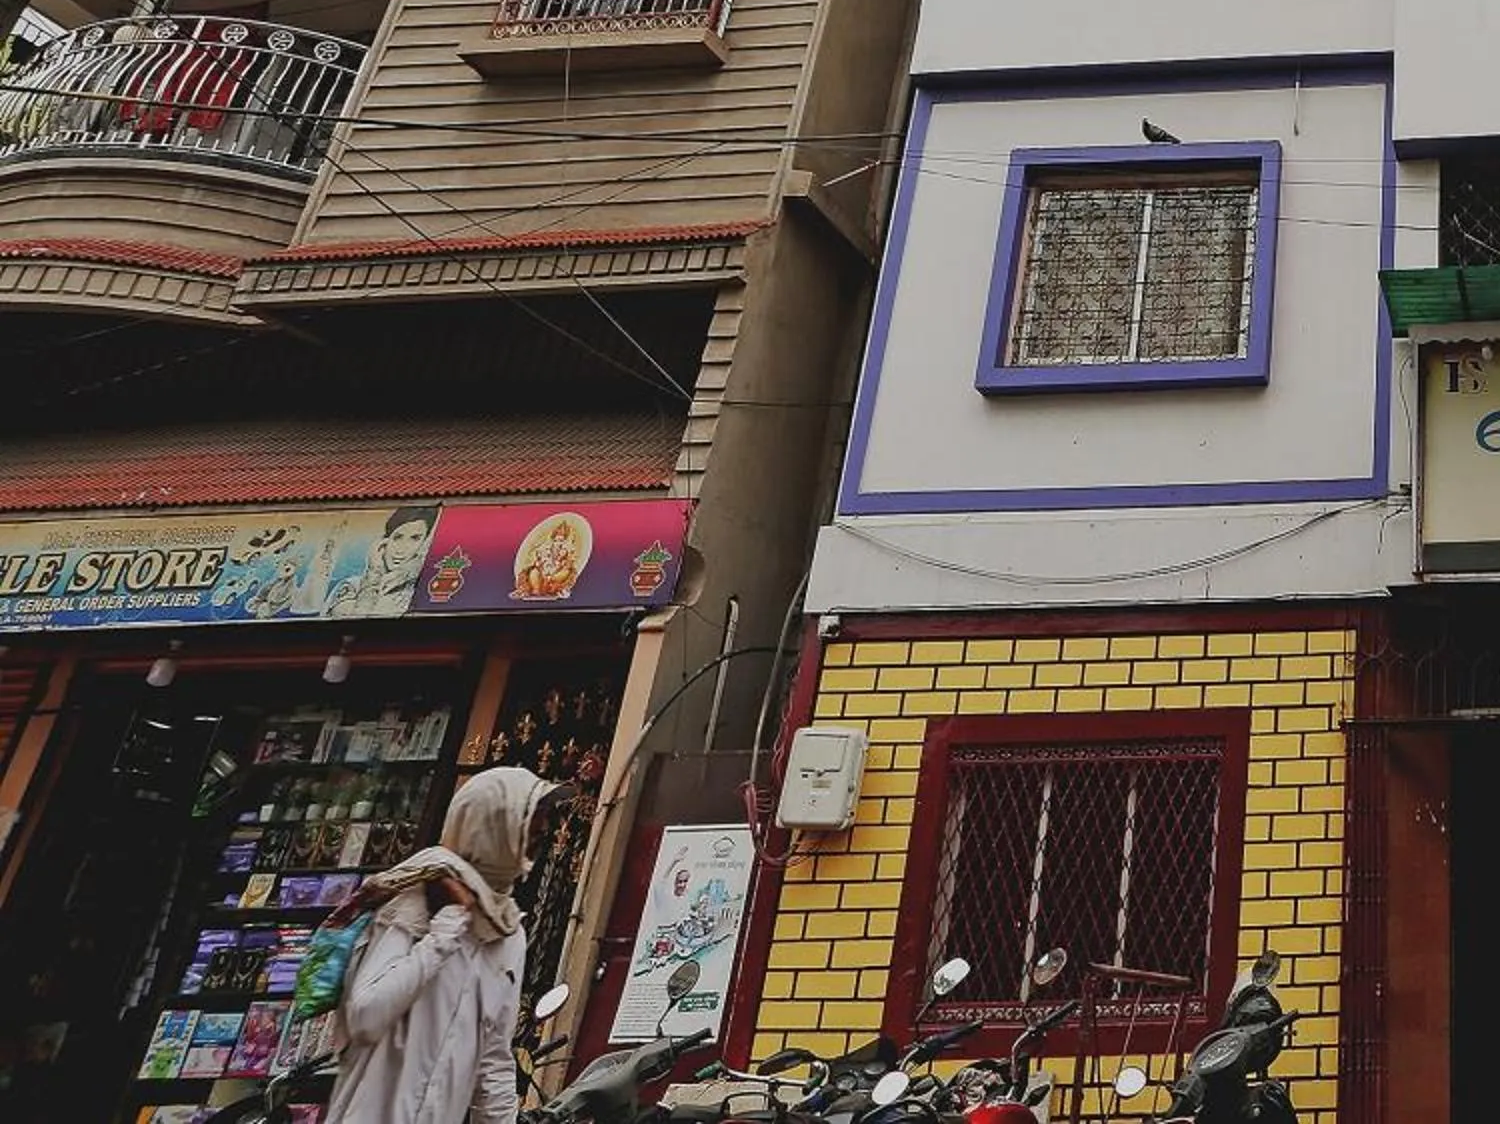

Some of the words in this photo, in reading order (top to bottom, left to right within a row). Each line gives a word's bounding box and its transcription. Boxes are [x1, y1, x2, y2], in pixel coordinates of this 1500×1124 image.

[66, 545, 228, 593] STORE
[15, 598, 74, 613] GENERAL
[80, 595, 126, 610] ORDER
[128, 592, 201, 610] SUPPLIERS
